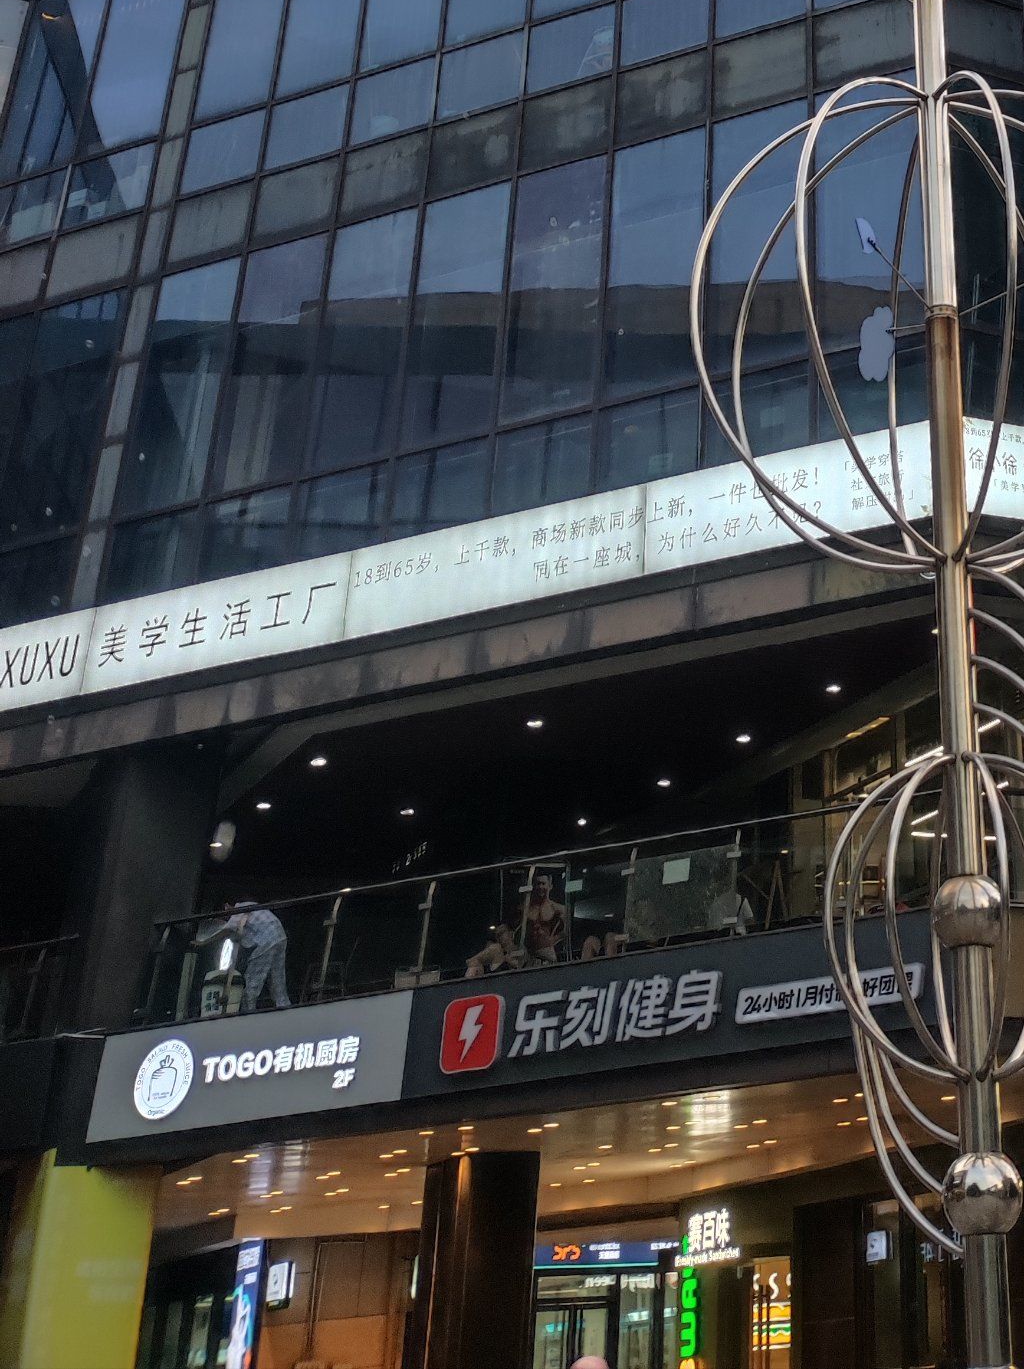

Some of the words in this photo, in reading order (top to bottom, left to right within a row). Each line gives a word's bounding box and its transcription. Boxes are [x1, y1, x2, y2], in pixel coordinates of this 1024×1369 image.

[97, 582, 337, 668] 美学生活工厂
[507, 970, 722, 1058] 乐刻健身
[202, 1035, 360, 1084] TOGO有机厨房
[331, 1068, 356, 1089] 2F
